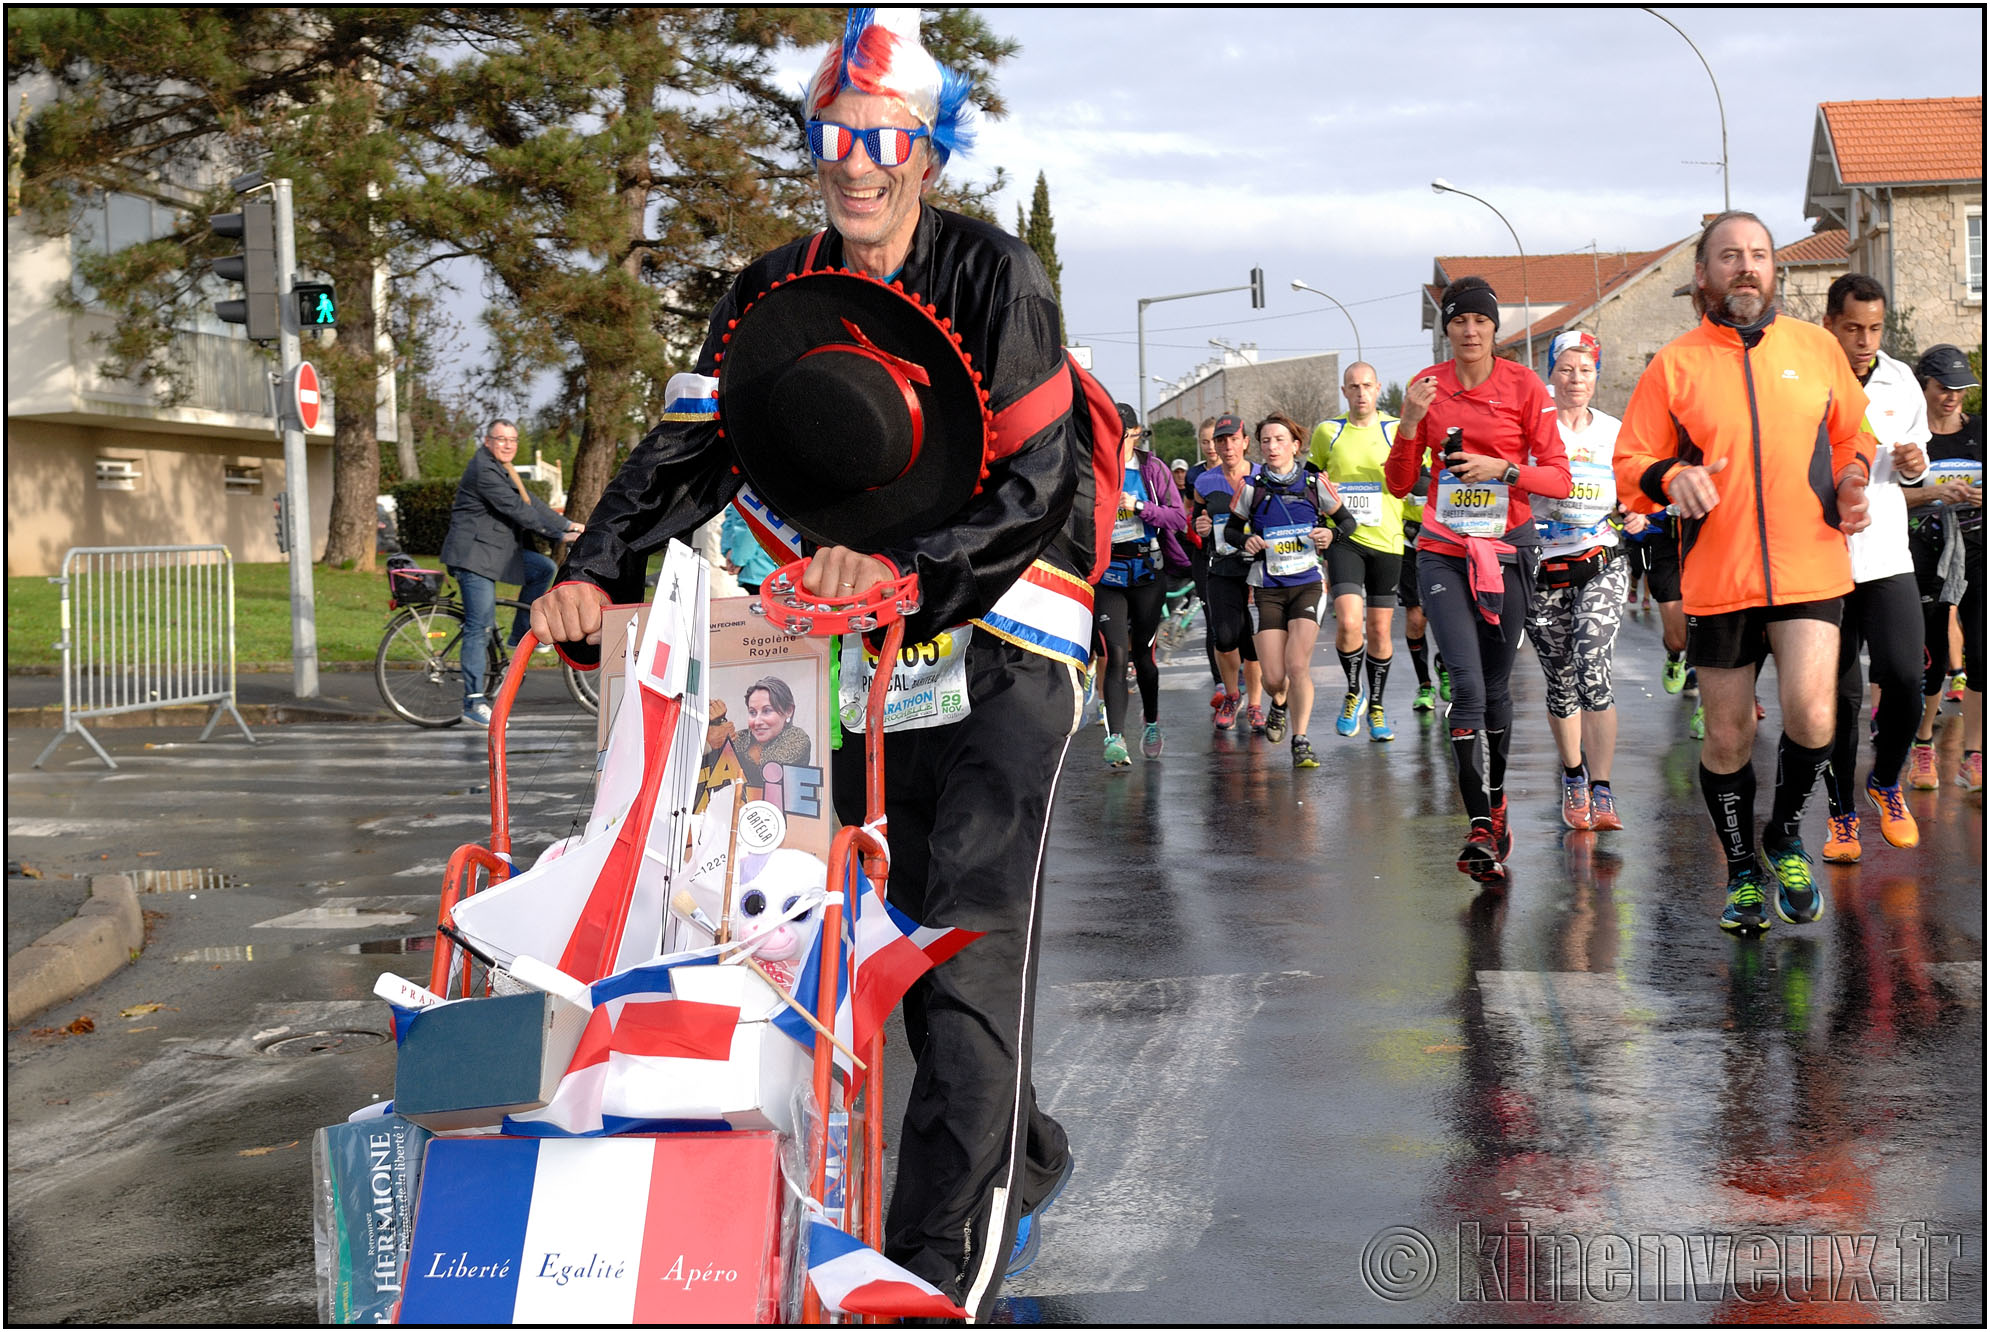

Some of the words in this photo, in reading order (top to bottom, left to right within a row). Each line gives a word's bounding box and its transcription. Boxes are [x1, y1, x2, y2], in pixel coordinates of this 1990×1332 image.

[1347, 495, 1369, 508] 7001
[1455, 488, 1491, 508] 3857
[742, 633, 797, 647] Ségolène
[750, 645, 790, 658] Royale
[941, 693, 961, 707] 29
[393, 1133, 406, 1171] liberté
[370, 1132, 401, 1294] HERMIONE
[424, 1252, 511, 1279] Liberté
[536, 1252, 625, 1286] Egalité
[660, 1255, 738, 1290] Apéro
